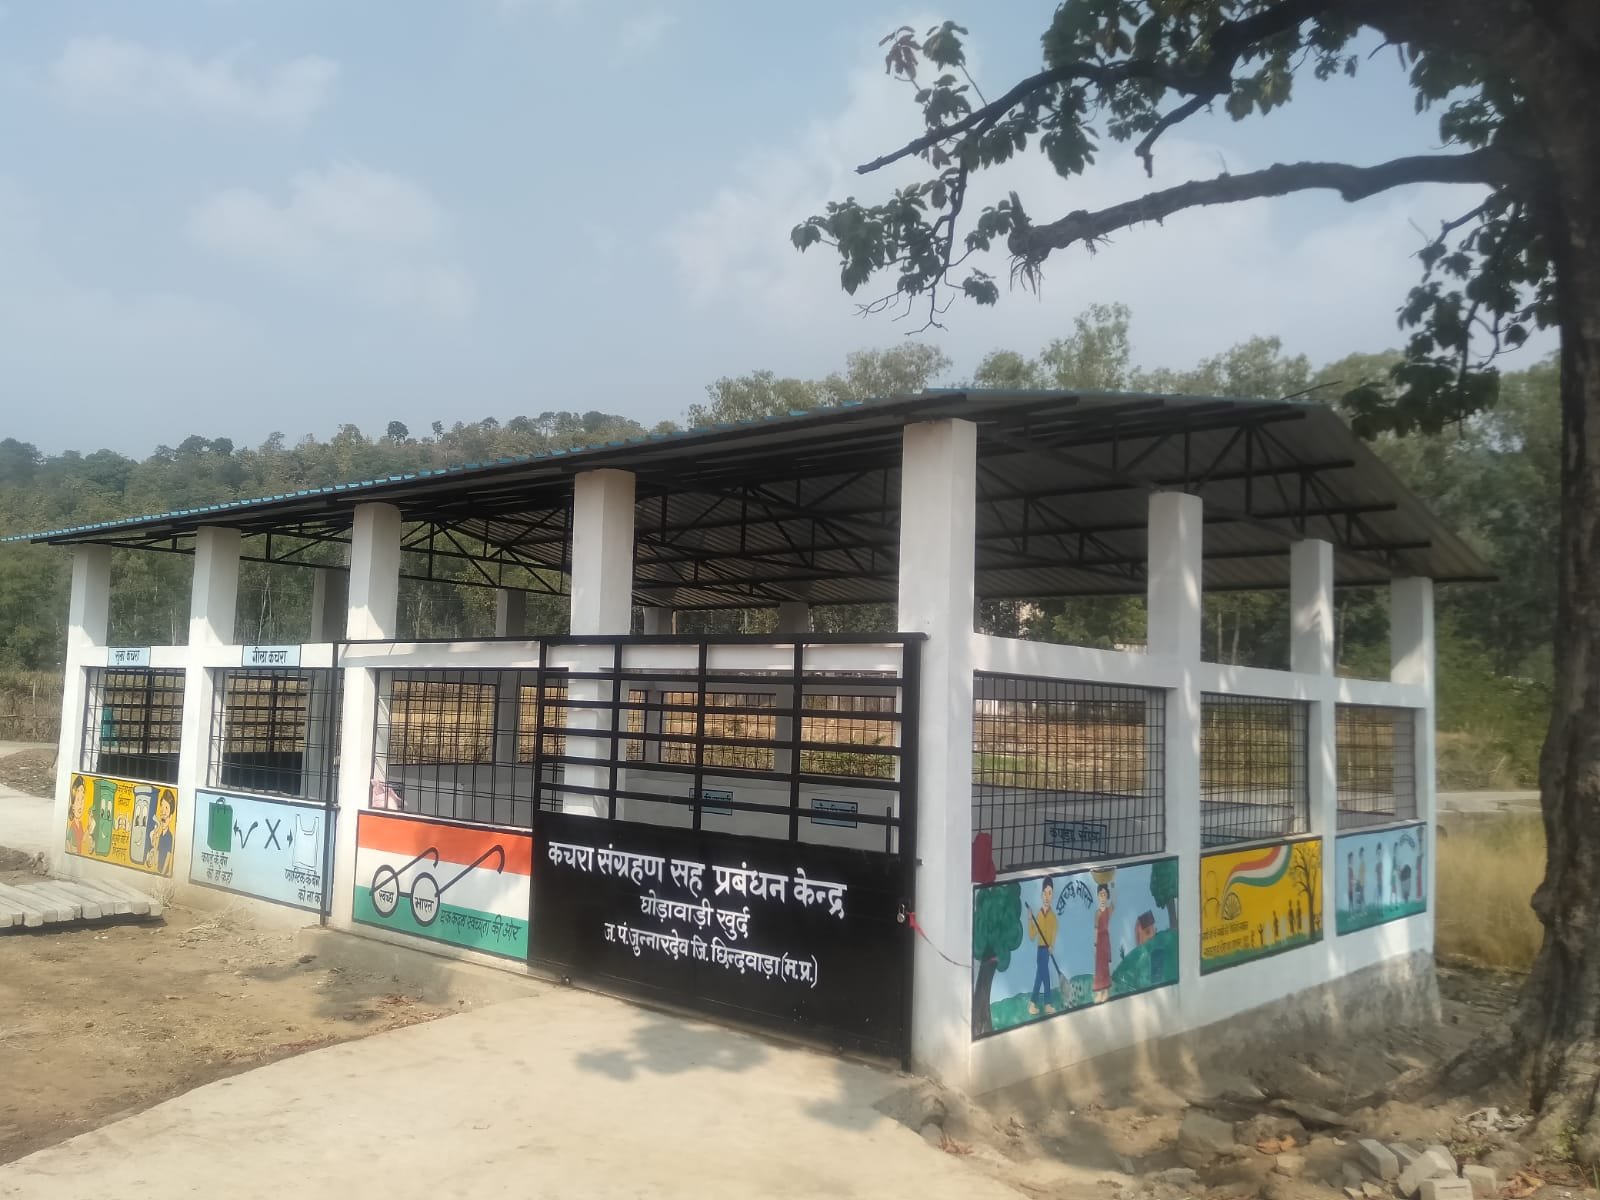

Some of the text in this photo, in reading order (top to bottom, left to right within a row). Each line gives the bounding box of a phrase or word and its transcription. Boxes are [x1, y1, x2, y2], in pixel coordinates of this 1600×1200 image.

[252, 646, 289, 664] गीला कचरा
[548, 841, 848, 919] कचरा संग्रहण सह प्रबंधन केन्द्र
[413, 896, 435, 913] भारत
[639, 889, 751, 941] घोड़ावाड़ी खुर्द
[491, 914, 504, 943] की
